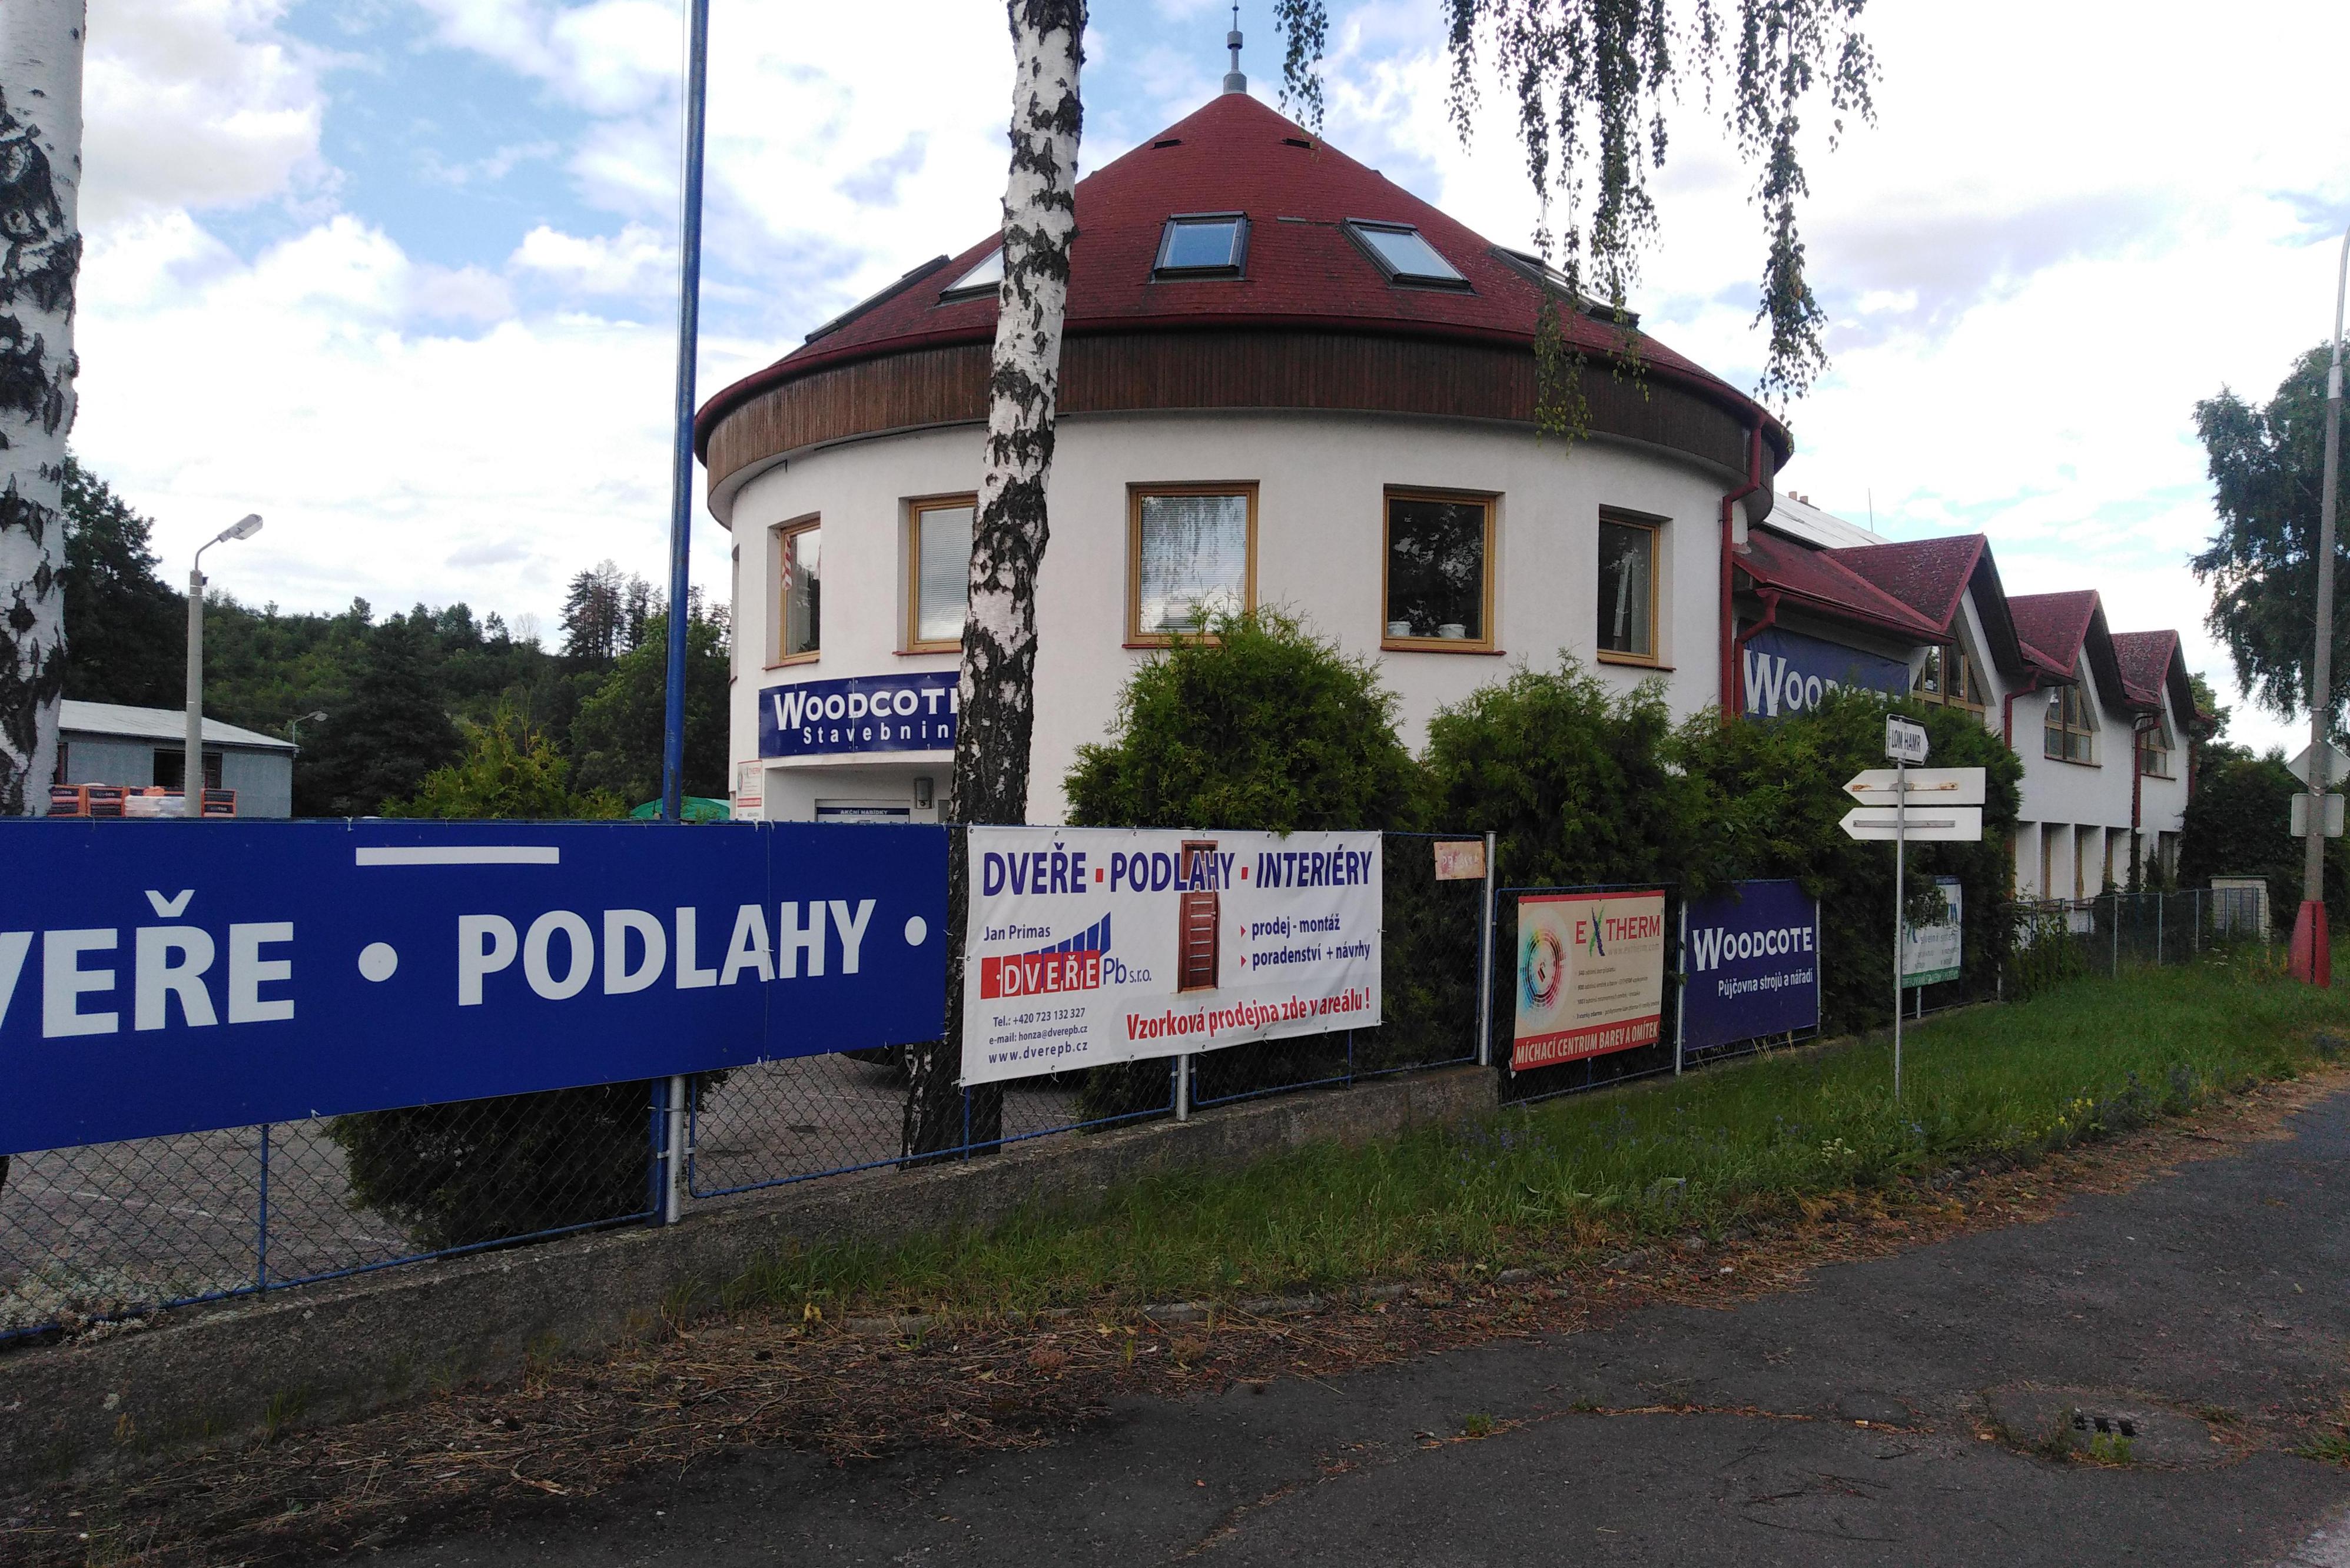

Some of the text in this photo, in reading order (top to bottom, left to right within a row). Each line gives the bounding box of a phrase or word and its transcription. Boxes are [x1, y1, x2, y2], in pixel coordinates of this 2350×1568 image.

[803, 720, 957, 745] Stavebnin
[1891, 729, 1921, 753] LOM HAMR
[983, 842, 1373, 896] DVEŘE PODLAHY INTERIÉRY
[984, 923, 1051, 941] Jan Primas
[1252, 916, 1290, 941] prodej
[1299, 913, 1340, 933] montáž
[1575, 904, 1661, 958] EXTHERM
[459, 899, 877, 1006] PODLAHY
[1252, 942, 1322, 971] poradenství
[1692, 926, 1813, 972] WOODCOTE
[1004, 955, 1152, 995] DVEŘE Pb s.r.o.
[1718, 967, 1813, 999] Půjčovna strojů a nářadí
[993, 1007, 1086, 1027] Tel.: +420 723 132 327
[1126, 1006, 1205, 1041] Vzorková
[1209, 999, 1279, 1037] prodejna
[1282, 995, 1307, 1021] zde
[1309, 999, 1318, 1017] v
[989, 1025, 1088, 1045] e-mail: honza@dverepb.cz
[1515, 1021, 1658, 1065] MÍCHACÍ CENTRUM BAREV A OMÍTEK
[988, 1041, 1088, 1064] www.dverepb.cz
